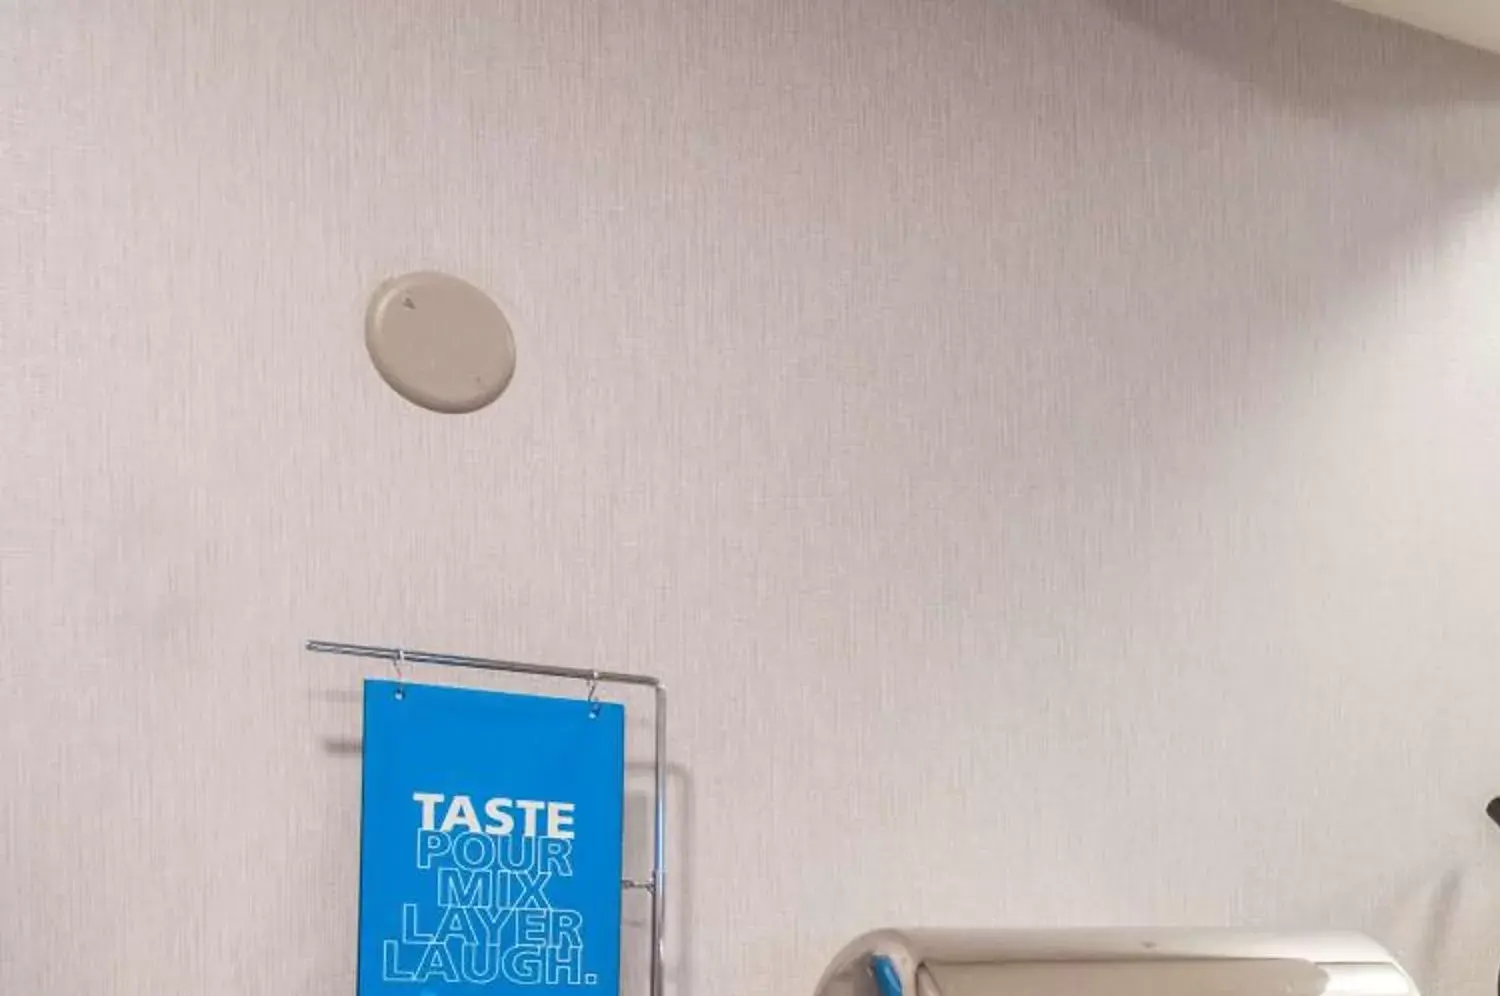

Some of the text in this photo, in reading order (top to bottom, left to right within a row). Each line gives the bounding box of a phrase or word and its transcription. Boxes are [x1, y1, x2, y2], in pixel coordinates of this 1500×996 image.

[413, 793, 575, 839] TASTE
[418, 828, 572, 876] POUR
[438, 868, 551, 910] MIX
[403, 904, 583, 948] LAYER
[383, 940, 598, 985] LAUGH.
